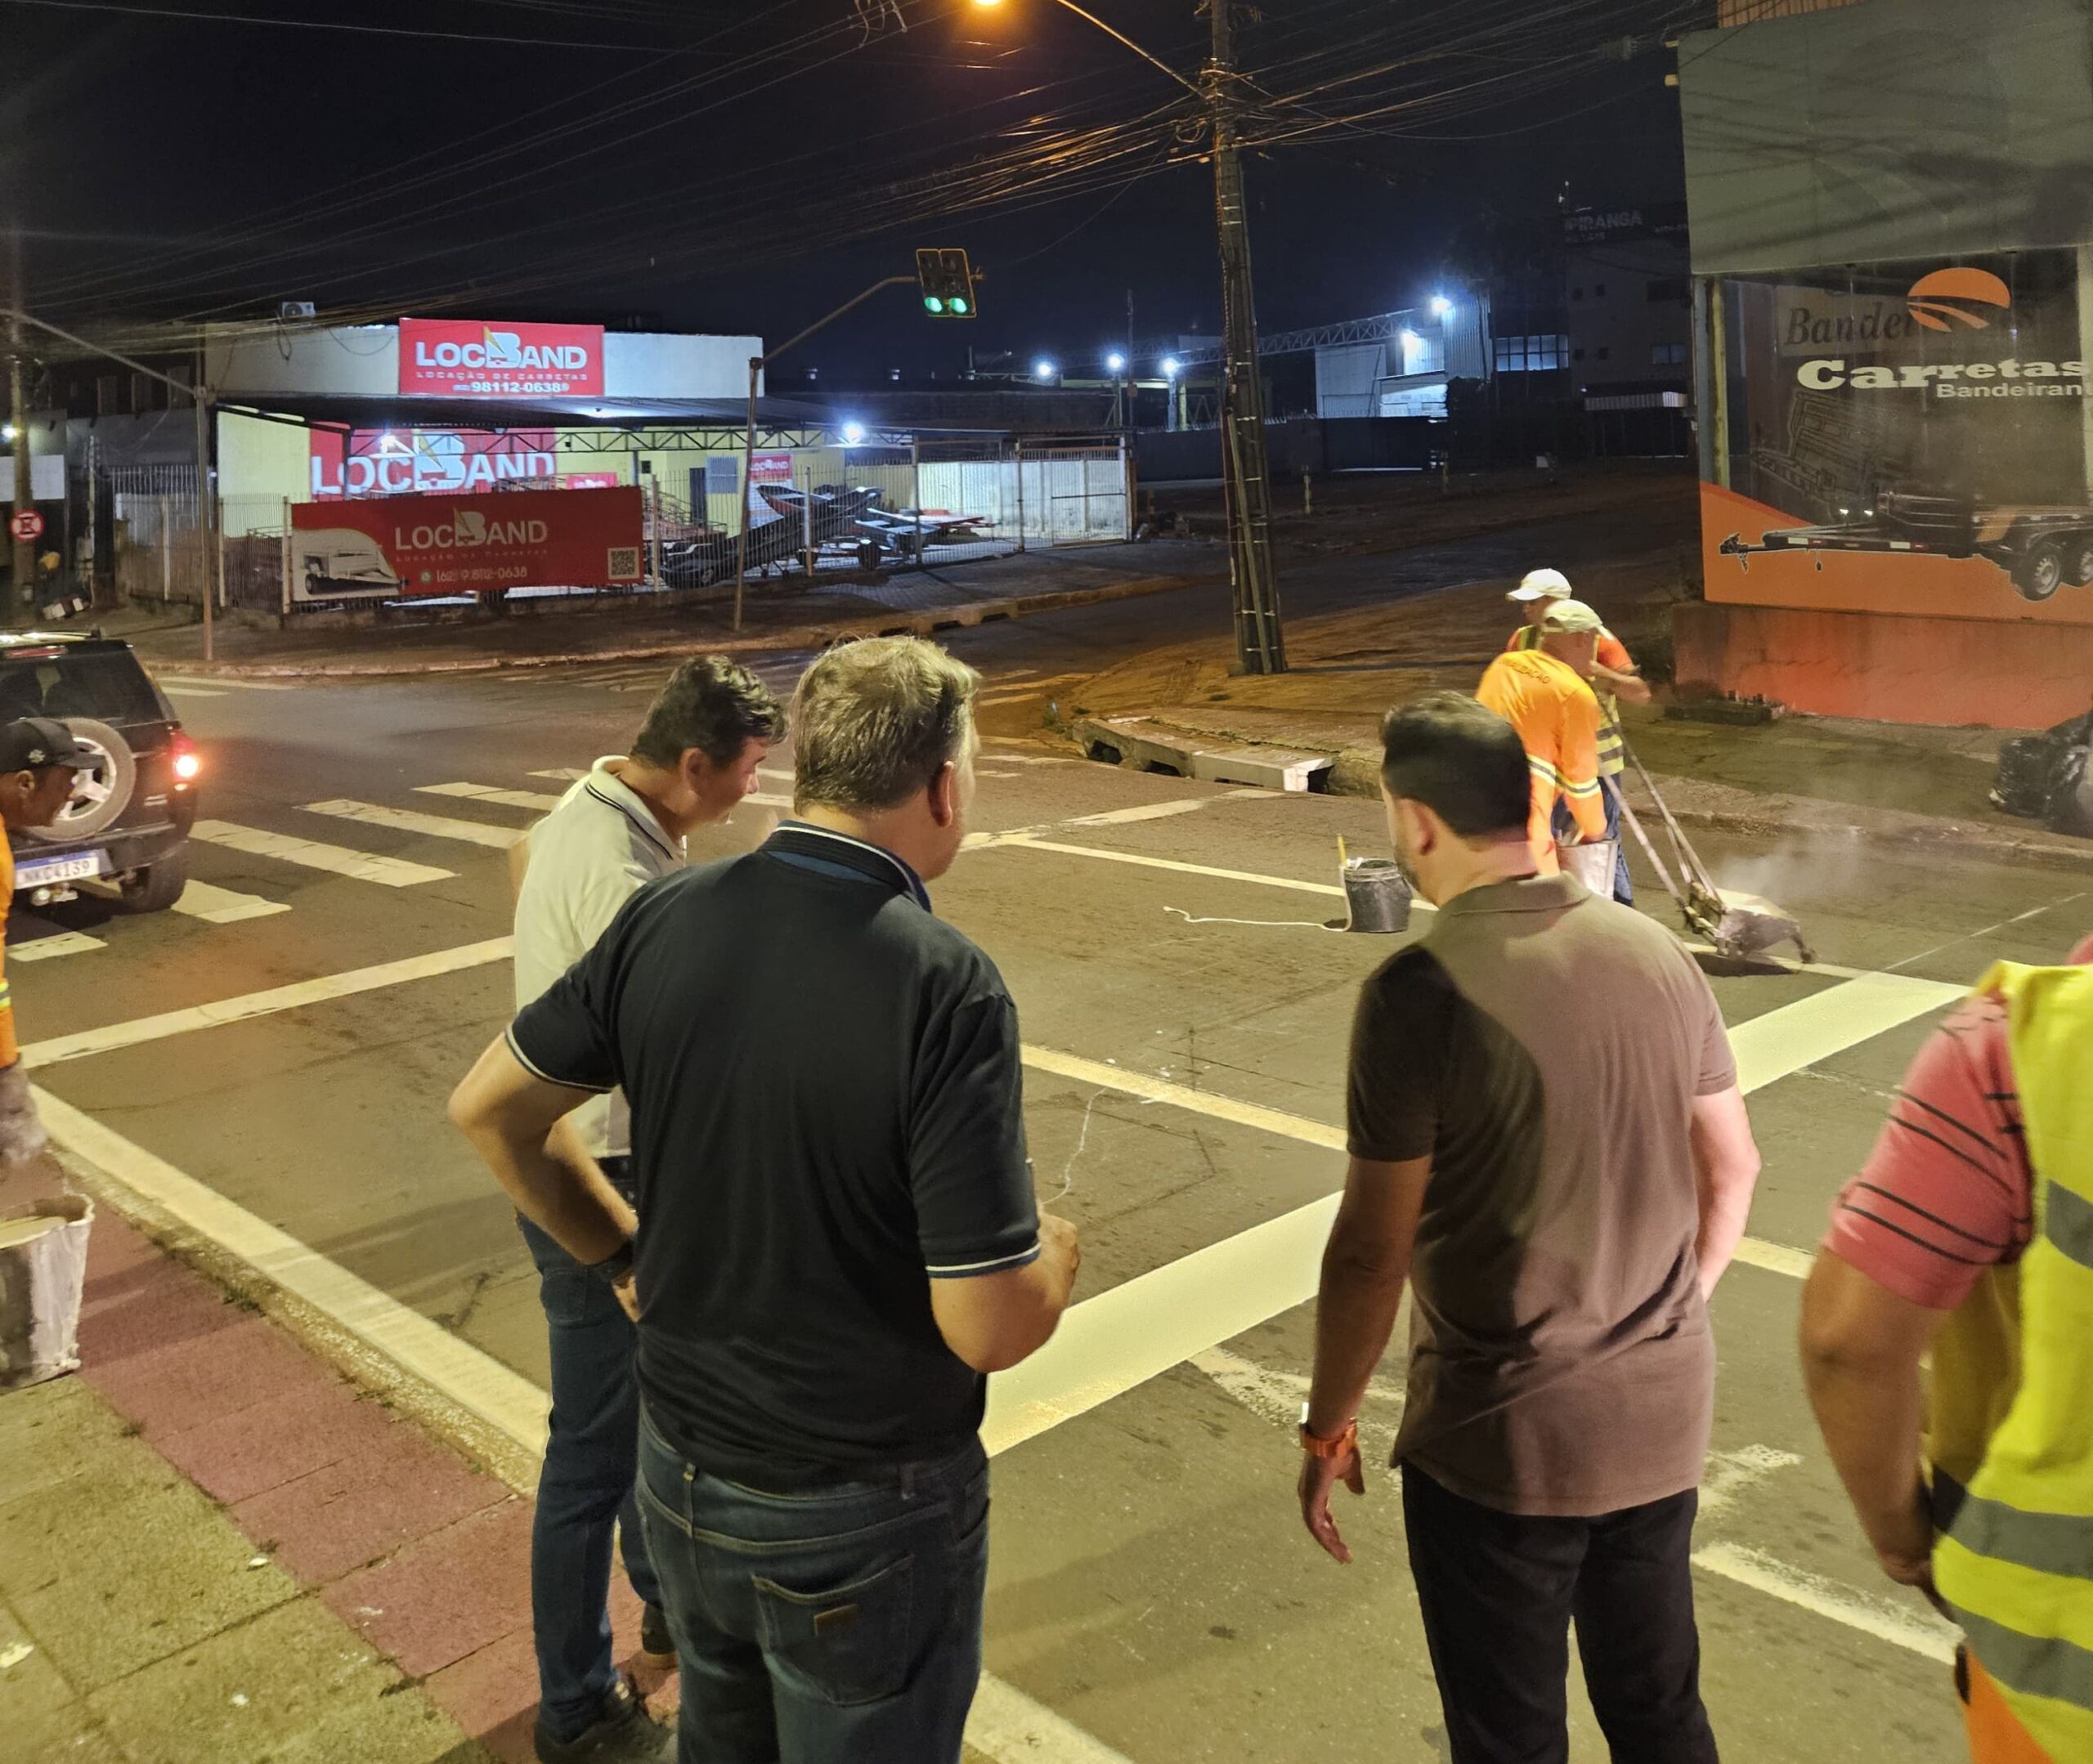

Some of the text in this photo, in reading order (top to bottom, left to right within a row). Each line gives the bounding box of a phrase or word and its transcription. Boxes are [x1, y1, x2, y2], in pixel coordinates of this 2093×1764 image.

[415, 331, 588, 369] LOCBAND
[415, 371, 486, 381] LOCAÇÃO
[518, 373, 588, 381] CARRETAS
[470, 382, 562, 392] 98112-0638
[1798, 358, 2086, 390] Carretas
[311, 432, 556, 495] LOCBAND
[394, 508, 549, 551] LOCBAND
